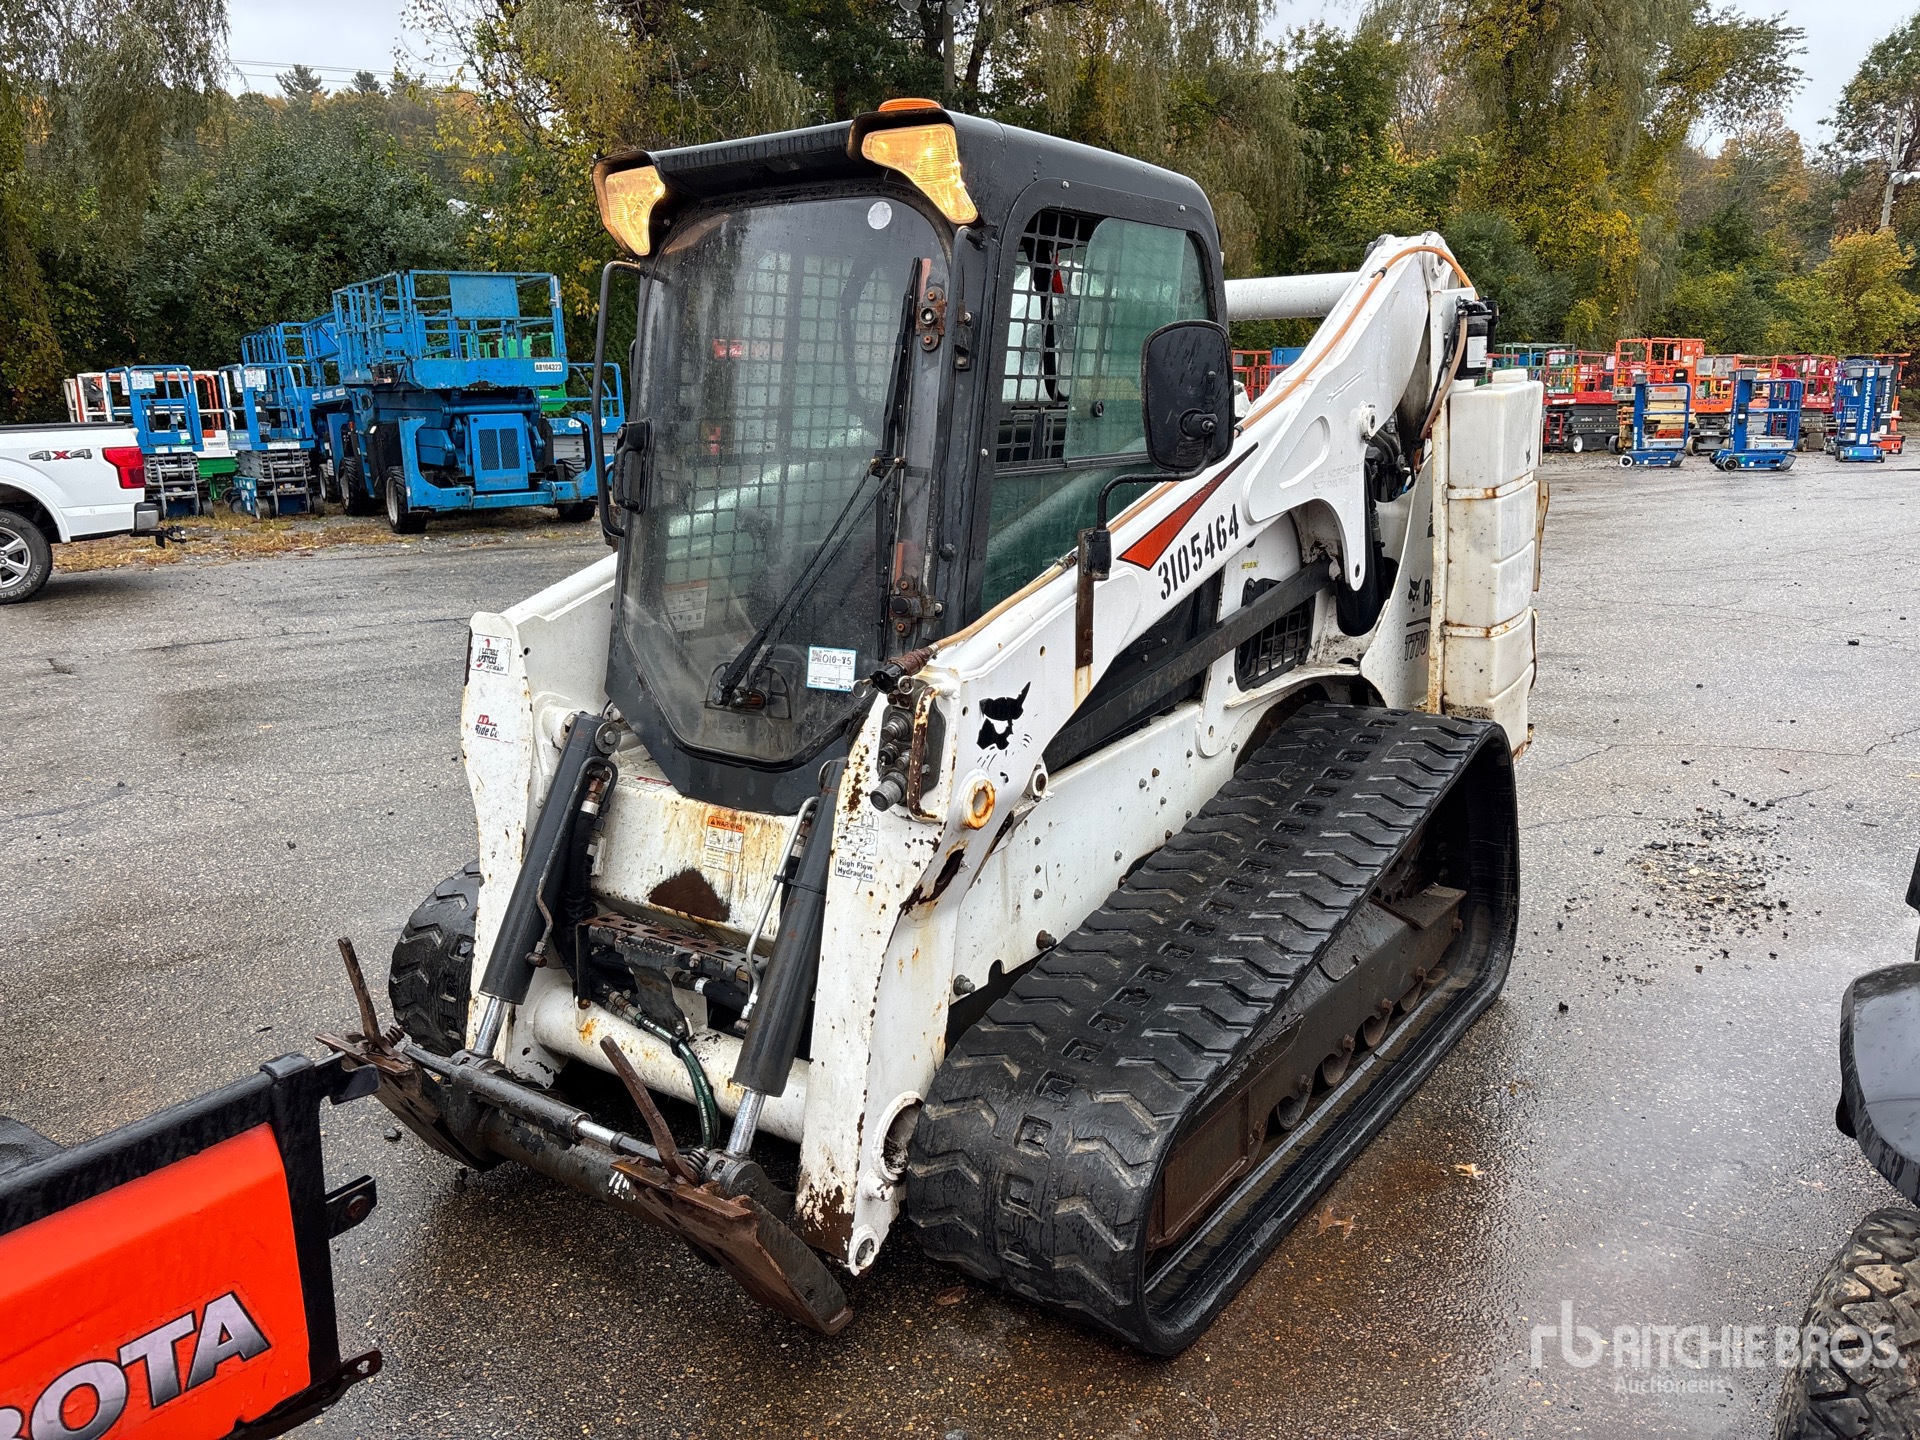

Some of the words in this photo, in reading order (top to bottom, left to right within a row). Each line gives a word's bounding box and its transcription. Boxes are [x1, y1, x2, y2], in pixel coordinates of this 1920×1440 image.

[1157, 503, 1239, 600] 3105464
[839, 858, 855, 868] High
[856, 862, 873, 871] Flow
